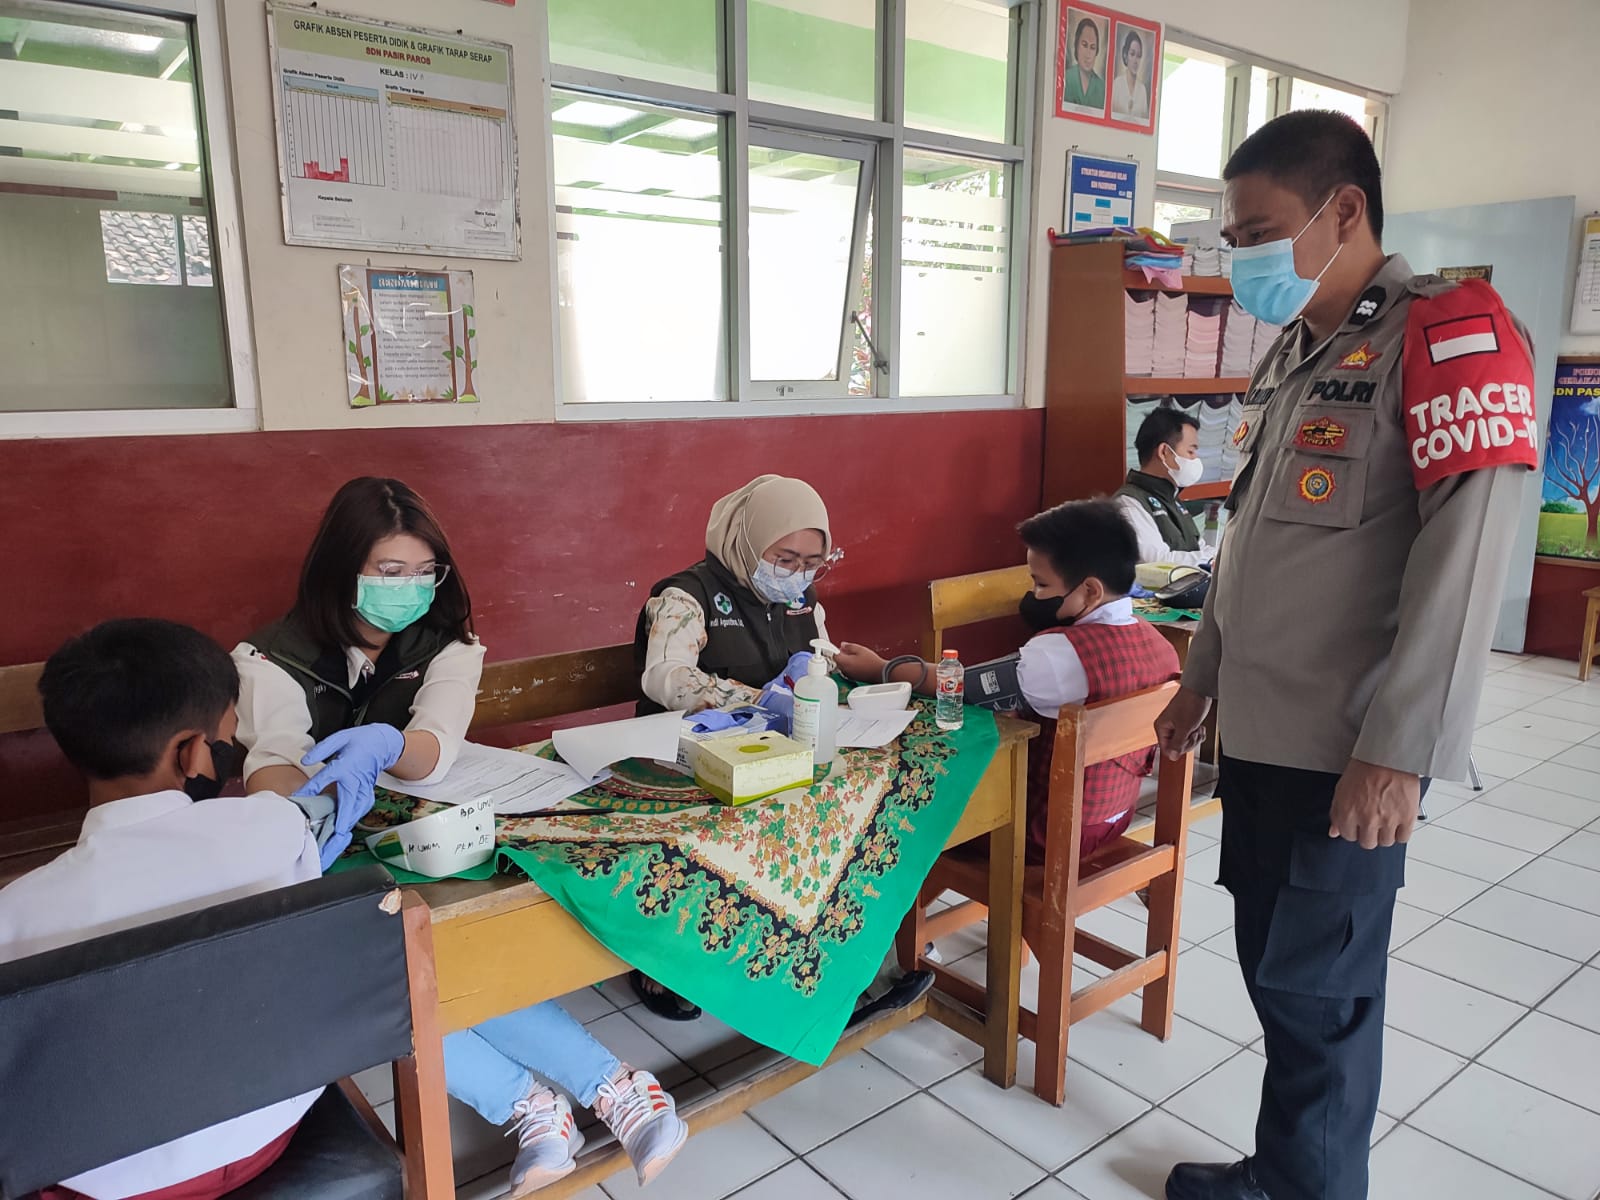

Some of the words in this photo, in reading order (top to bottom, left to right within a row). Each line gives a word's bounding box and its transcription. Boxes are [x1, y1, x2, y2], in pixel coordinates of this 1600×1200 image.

[293, 19, 324, 34] GRAFIK
[325, 26, 352, 39] ABSEN
[353, 30, 388, 45] PESERTA
[389, 38, 409, 49] DIDIK
[410, 42, 416, 50] &
[417, 42, 444, 54] GRAFIK
[445, 47, 469, 59] TARAP
[469, 51, 493, 63] SERAP
[366, 46, 382, 57] SDN
[383, 49, 405, 61] PASIR
[406, 54, 431, 65] PAROS
[380, 67, 404, 78] KELAS
[1307, 379, 1378, 403] POLRI
[1554, 387, 1574, 396] DN
[1409, 382, 1533, 433] TRACER
